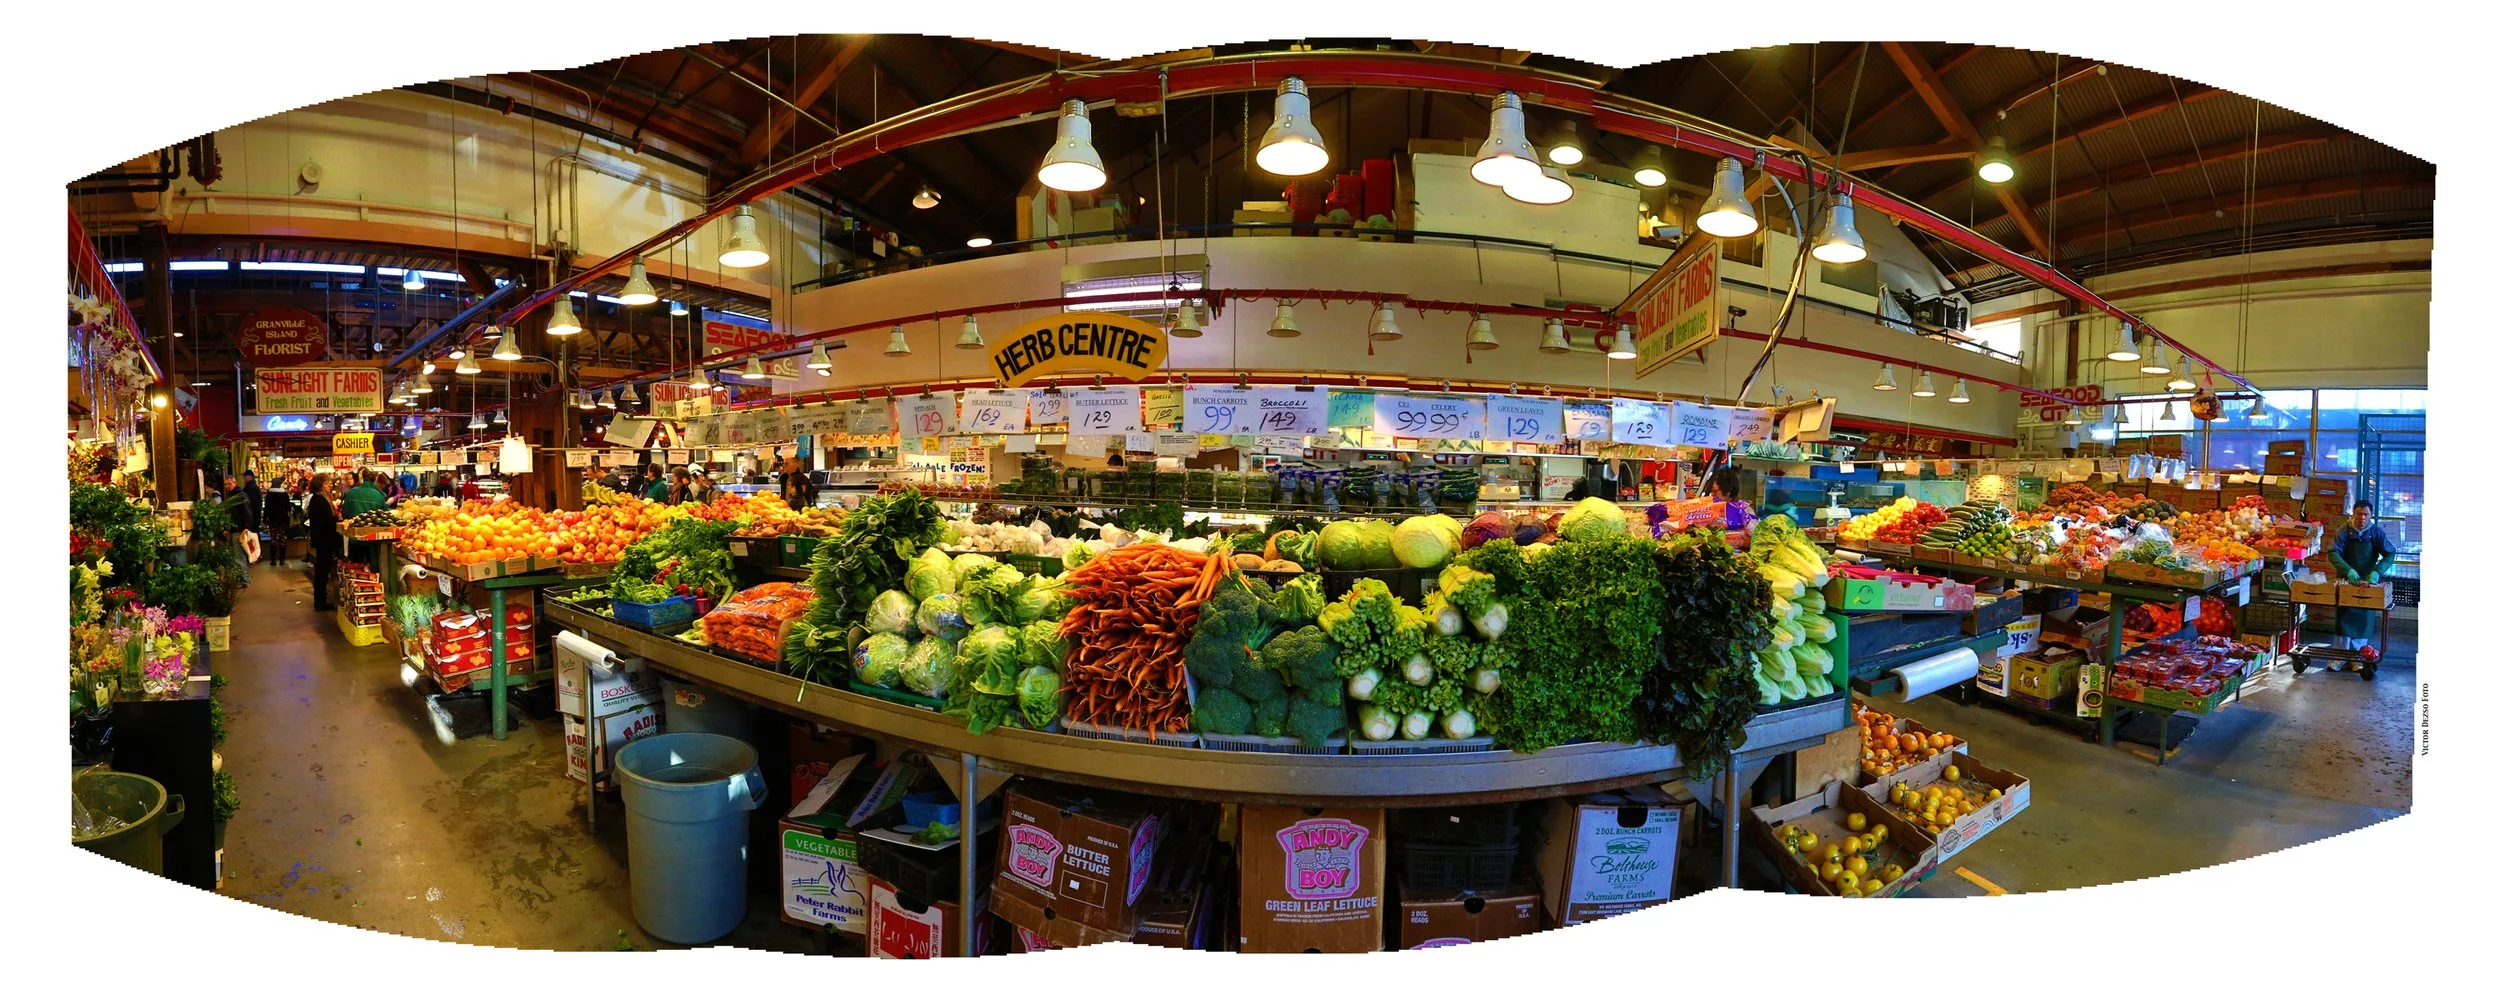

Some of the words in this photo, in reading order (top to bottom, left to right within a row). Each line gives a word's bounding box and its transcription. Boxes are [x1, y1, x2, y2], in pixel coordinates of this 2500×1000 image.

[1640, 281, 1676, 341] SUNLIGHT
[1678, 252, 1713, 316] FARMS
[256, 320, 305, 328] GRANVILLE
[1665, 328, 1674, 352] and
[1675, 310, 1707, 346] Vegetables
[266, 330, 297, 338] ISLAND
[254, 343, 311, 355] FLORIST
[994, 328, 1055, 382] HERB
[1058, 323, 1157, 369] CENTRE
[262, 372, 328, 393] SUNLIGHT
[334, 372, 377, 393] FARMS
[266, 397, 288, 409] Fresh
[291, 397, 312, 409] Fruit
[316, 397, 329, 408] and
[332, 396, 373, 408] Vegetables
[1261, 399, 1306, 407] BROCCOLI
[1520, 407, 1545, 415] LEAVES
[1683, 415, 1717, 426] ROMAINE
[336, 438, 369, 449] CASHIER
[334, 456, 352, 467] OPEN
[603, 695, 629, 707] QUALITY
[1023, 813, 1035, 823] HEADS
[1016, 829, 1056, 853] ANDY
[1291, 828, 1358, 852] ANDY
[796, 839, 857, 859] VEGETABLE
[1067, 844, 1109, 865] BUTTER
[1017, 855, 1047, 879] BOY
[1063, 854, 1110, 877] LETTUCE
[1591, 855, 1658, 874] Bolthouse
[1298, 867, 1351, 890] BOY
[1608, 873, 1644, 883] FARMS
[1585, 891, 1623, 901] Premium
[1626, 889, 1656, 899] Carrots
[796, 895, 825, 908] Peter
[827, 902, 865, 917] Rabbit
[1265, 900, 1300, 912] GREEN
[1304, 899, 1331, 912] LEAF
[1333, 896, 1378, 911] LETTUCE
[812, 908, 846, 923] Farms
